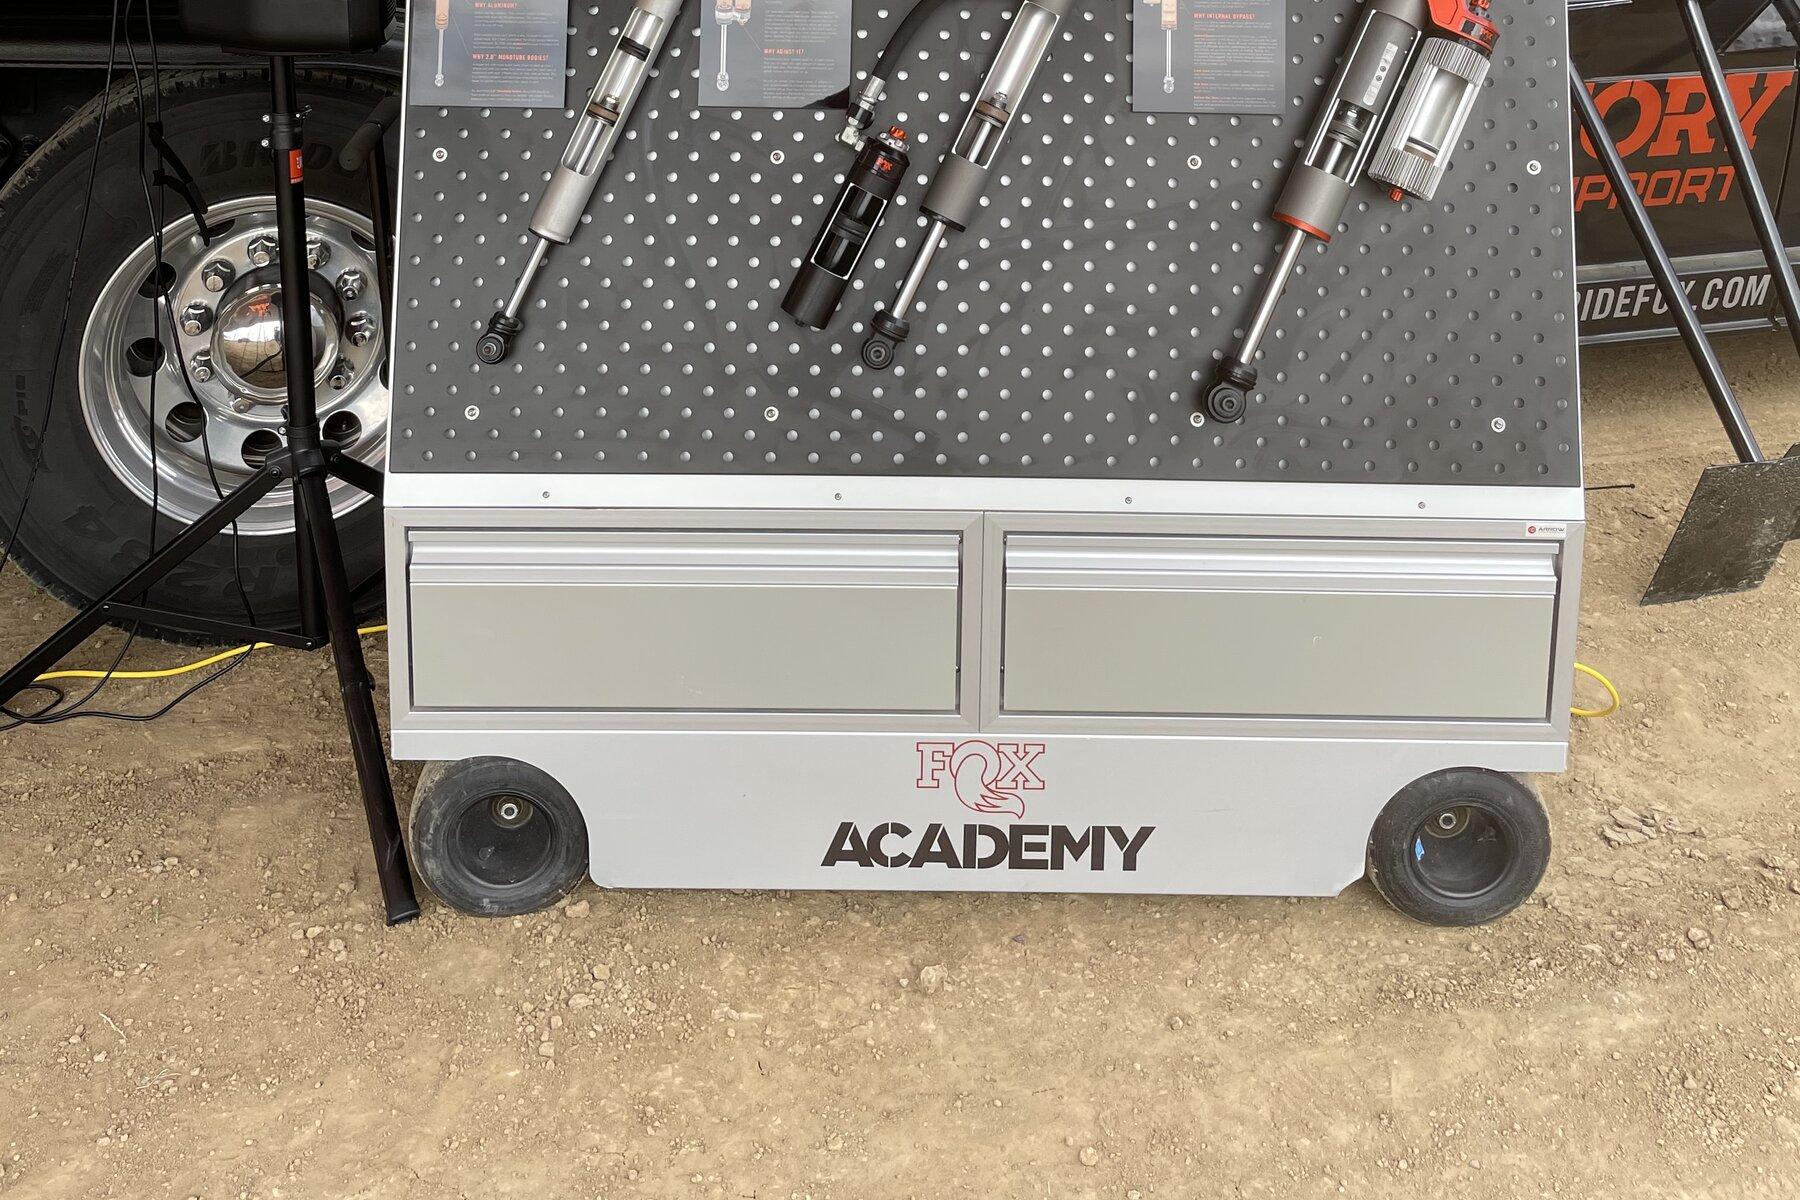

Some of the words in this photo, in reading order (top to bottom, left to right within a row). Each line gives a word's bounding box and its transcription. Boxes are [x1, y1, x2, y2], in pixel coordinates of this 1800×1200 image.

[1580, 72, 1793, 158] ORY
[916, 740, 1046, 819] FOX
[820, 821, 1157, 871] ACADEMY
